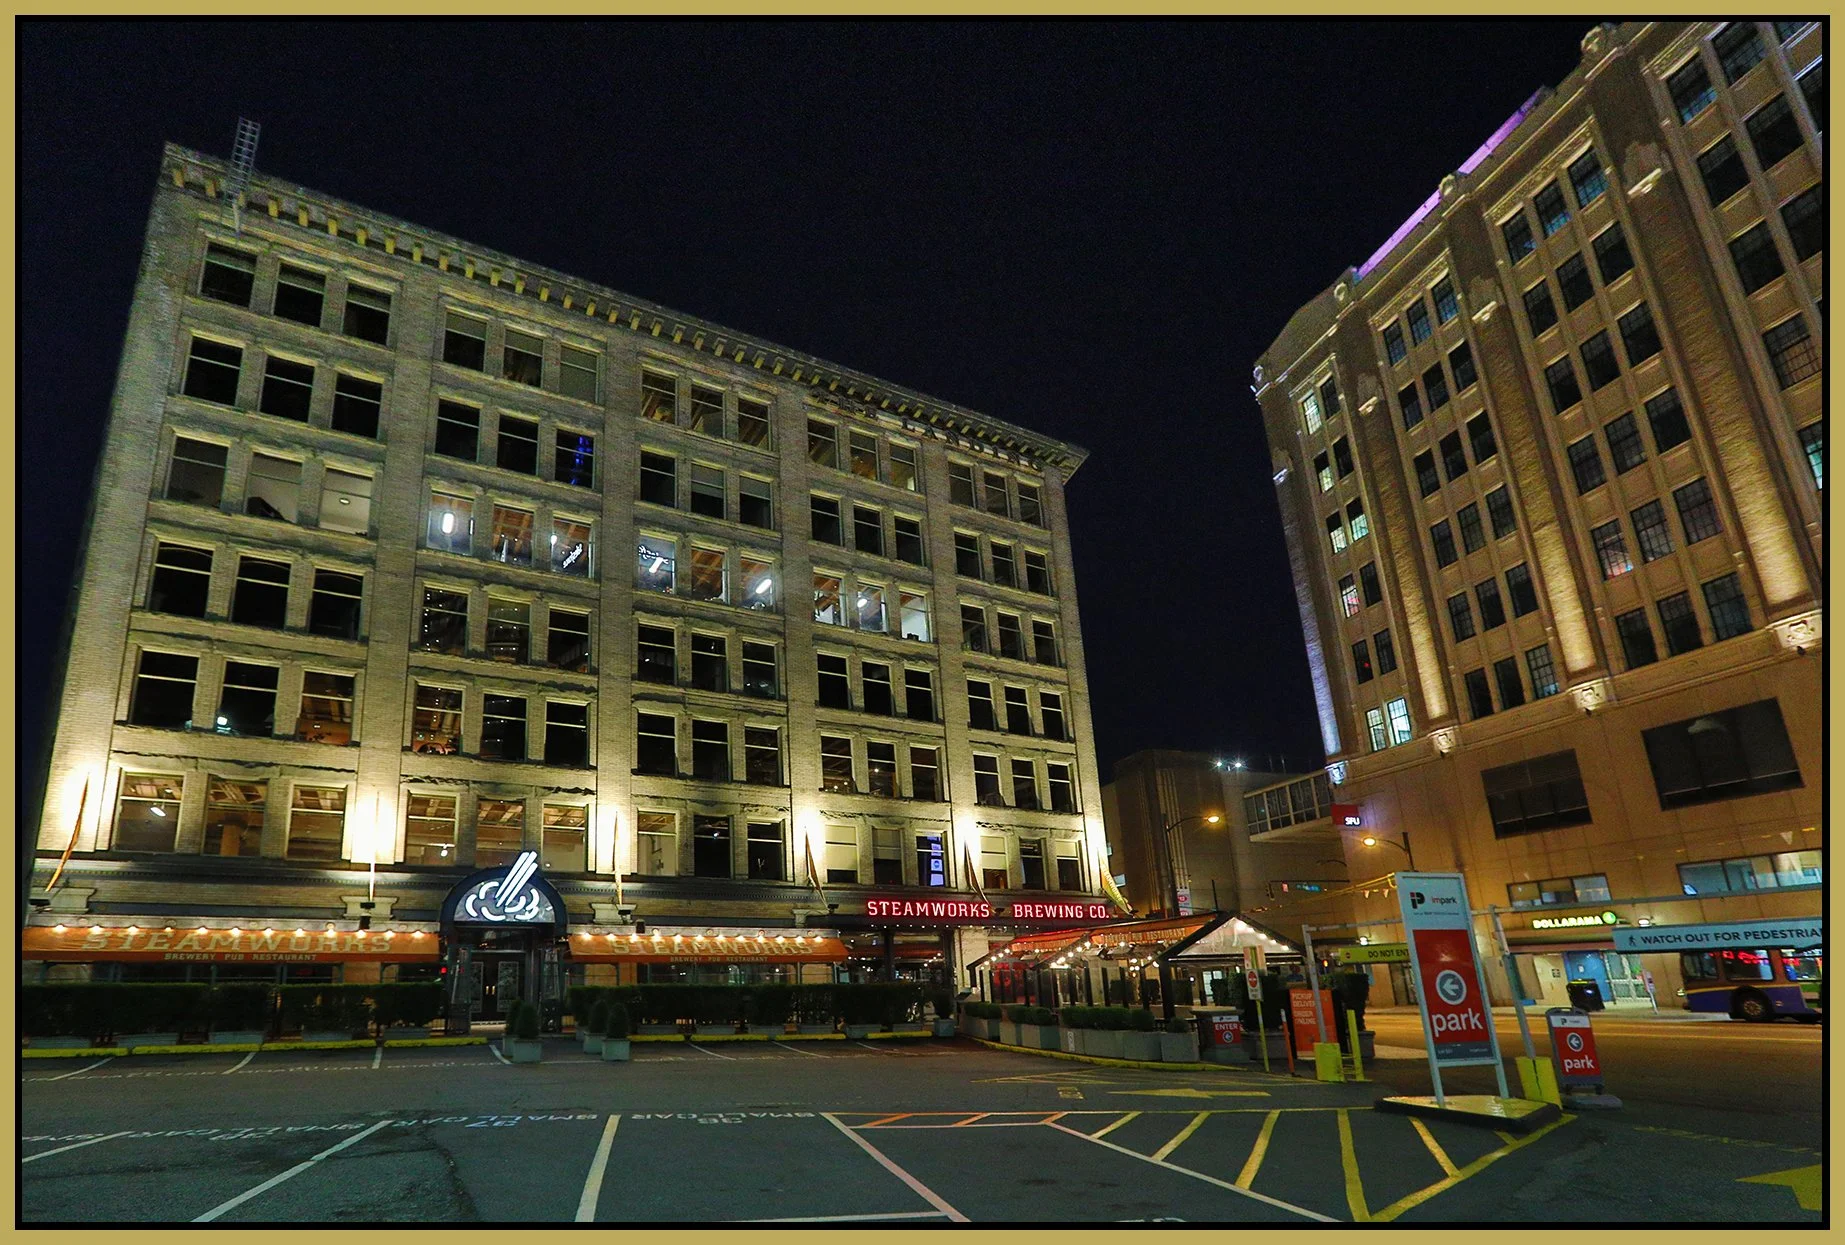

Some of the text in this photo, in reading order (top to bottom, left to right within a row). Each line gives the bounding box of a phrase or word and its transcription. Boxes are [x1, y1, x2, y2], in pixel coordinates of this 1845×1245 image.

[902, 414, 1042, 472] LANDING
[1344, 816, 1360, 825] SFU
[1431, 896, 1458, 905] impark
[868, 901, 1110, 919] STEAMWORKS BREWING CO.
[1532, 915, 1604, 929] DOLLARAMA
[81, 930, 392, 952] STEAMWORKS
[1640, 934, 1682, 945] WATCH
[1685, 933, 1711, 944] OUT
[1714, 931, 1741, 942] FOR
[612, 938, 813, 955] STEAMWORKS
[1367, 948, 1409, 958] DO NOT ENT
[164, 952, 318, 962] BREWERY PUB RESTAURANT
[1215, 1023, 1239, 1031] ENTER
[1431, 1007, 1484, 1038] park
[1563, 1054, 1595, 1073] park
